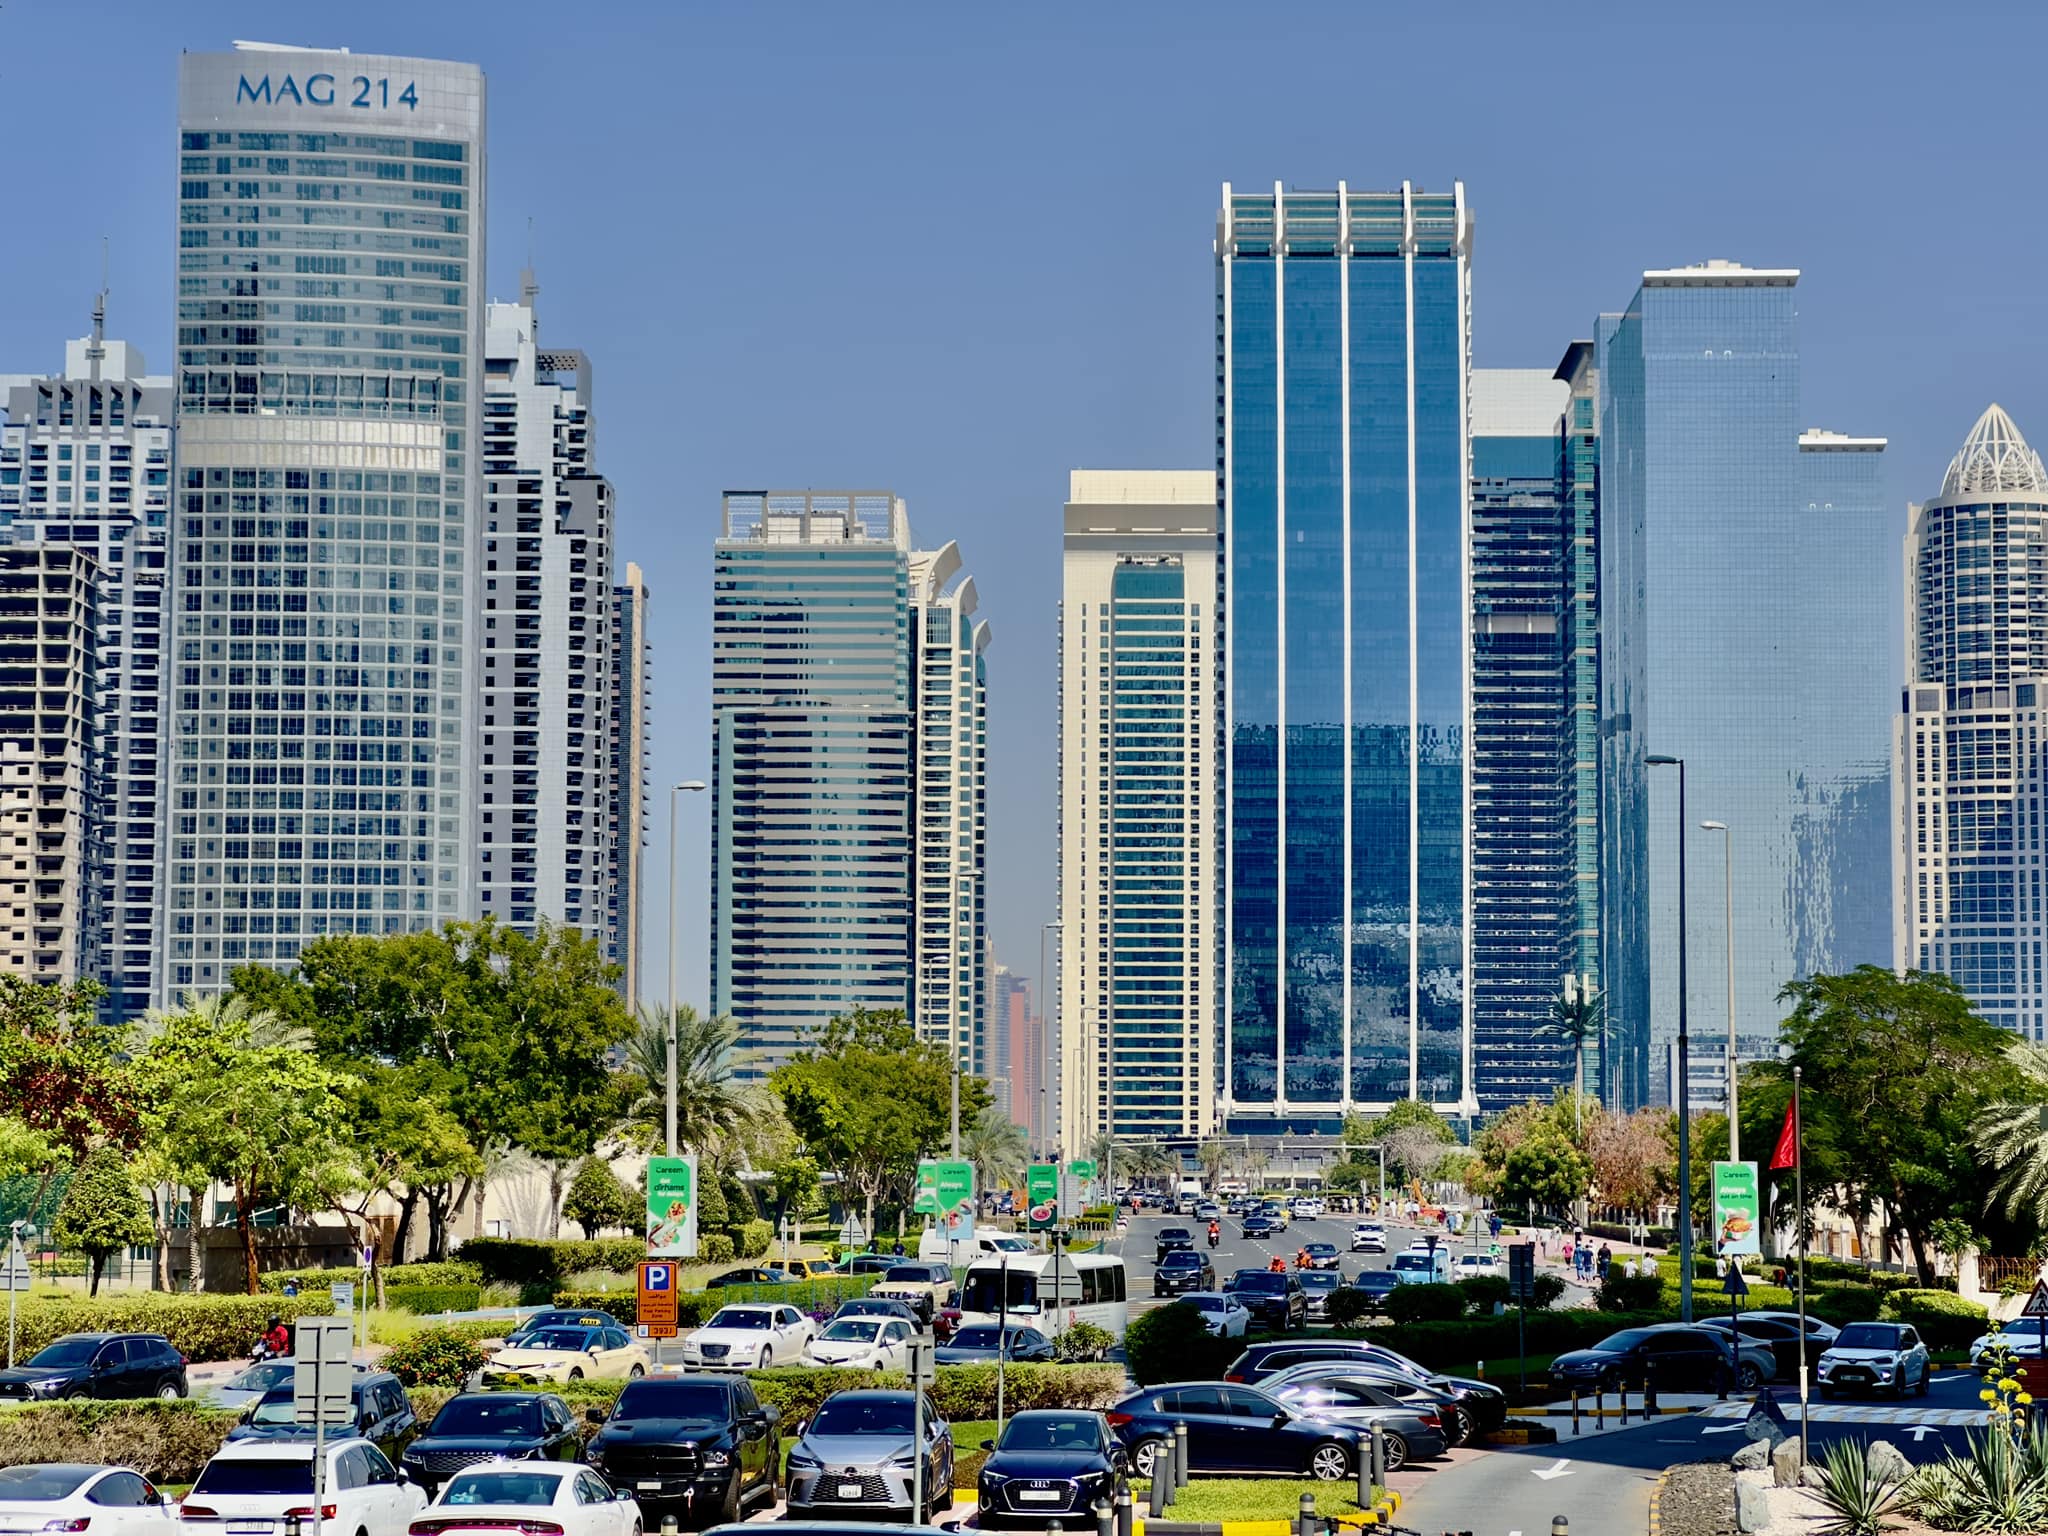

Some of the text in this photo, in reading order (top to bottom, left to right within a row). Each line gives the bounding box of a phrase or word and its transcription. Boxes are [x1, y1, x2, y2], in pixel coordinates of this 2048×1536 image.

[236, 73, 419, 111] MAG 214
[655, 1166, 684, 1174] Careem
[654, 1183, 685, 1191] dirhams
[648, 1266, 666, 1290] P
